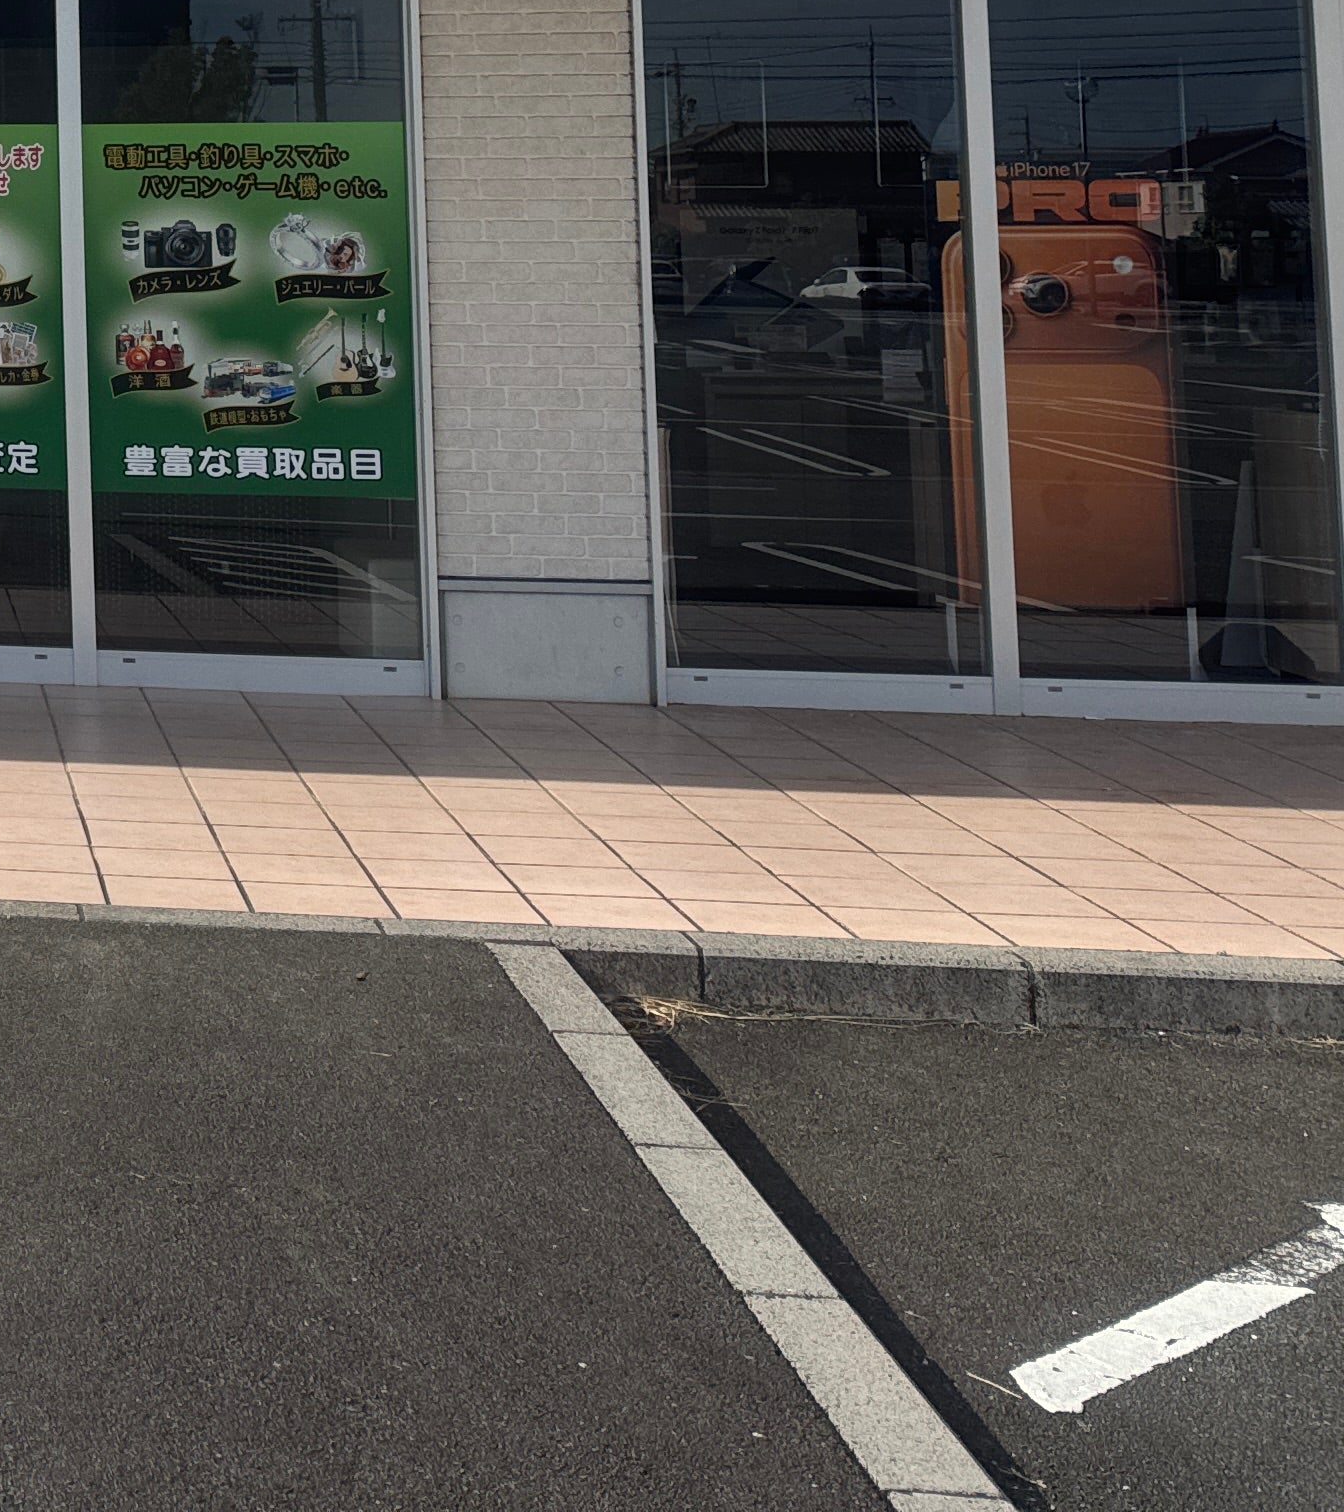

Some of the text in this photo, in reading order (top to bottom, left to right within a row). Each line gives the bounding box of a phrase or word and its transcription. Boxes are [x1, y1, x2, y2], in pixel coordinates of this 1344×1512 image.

[1010, 162, 1091, 177] iPhone 17
[137, 272, 222, 295] カメラ・レンズ
[124, 445, 382, 480] 豊富な買取品目
